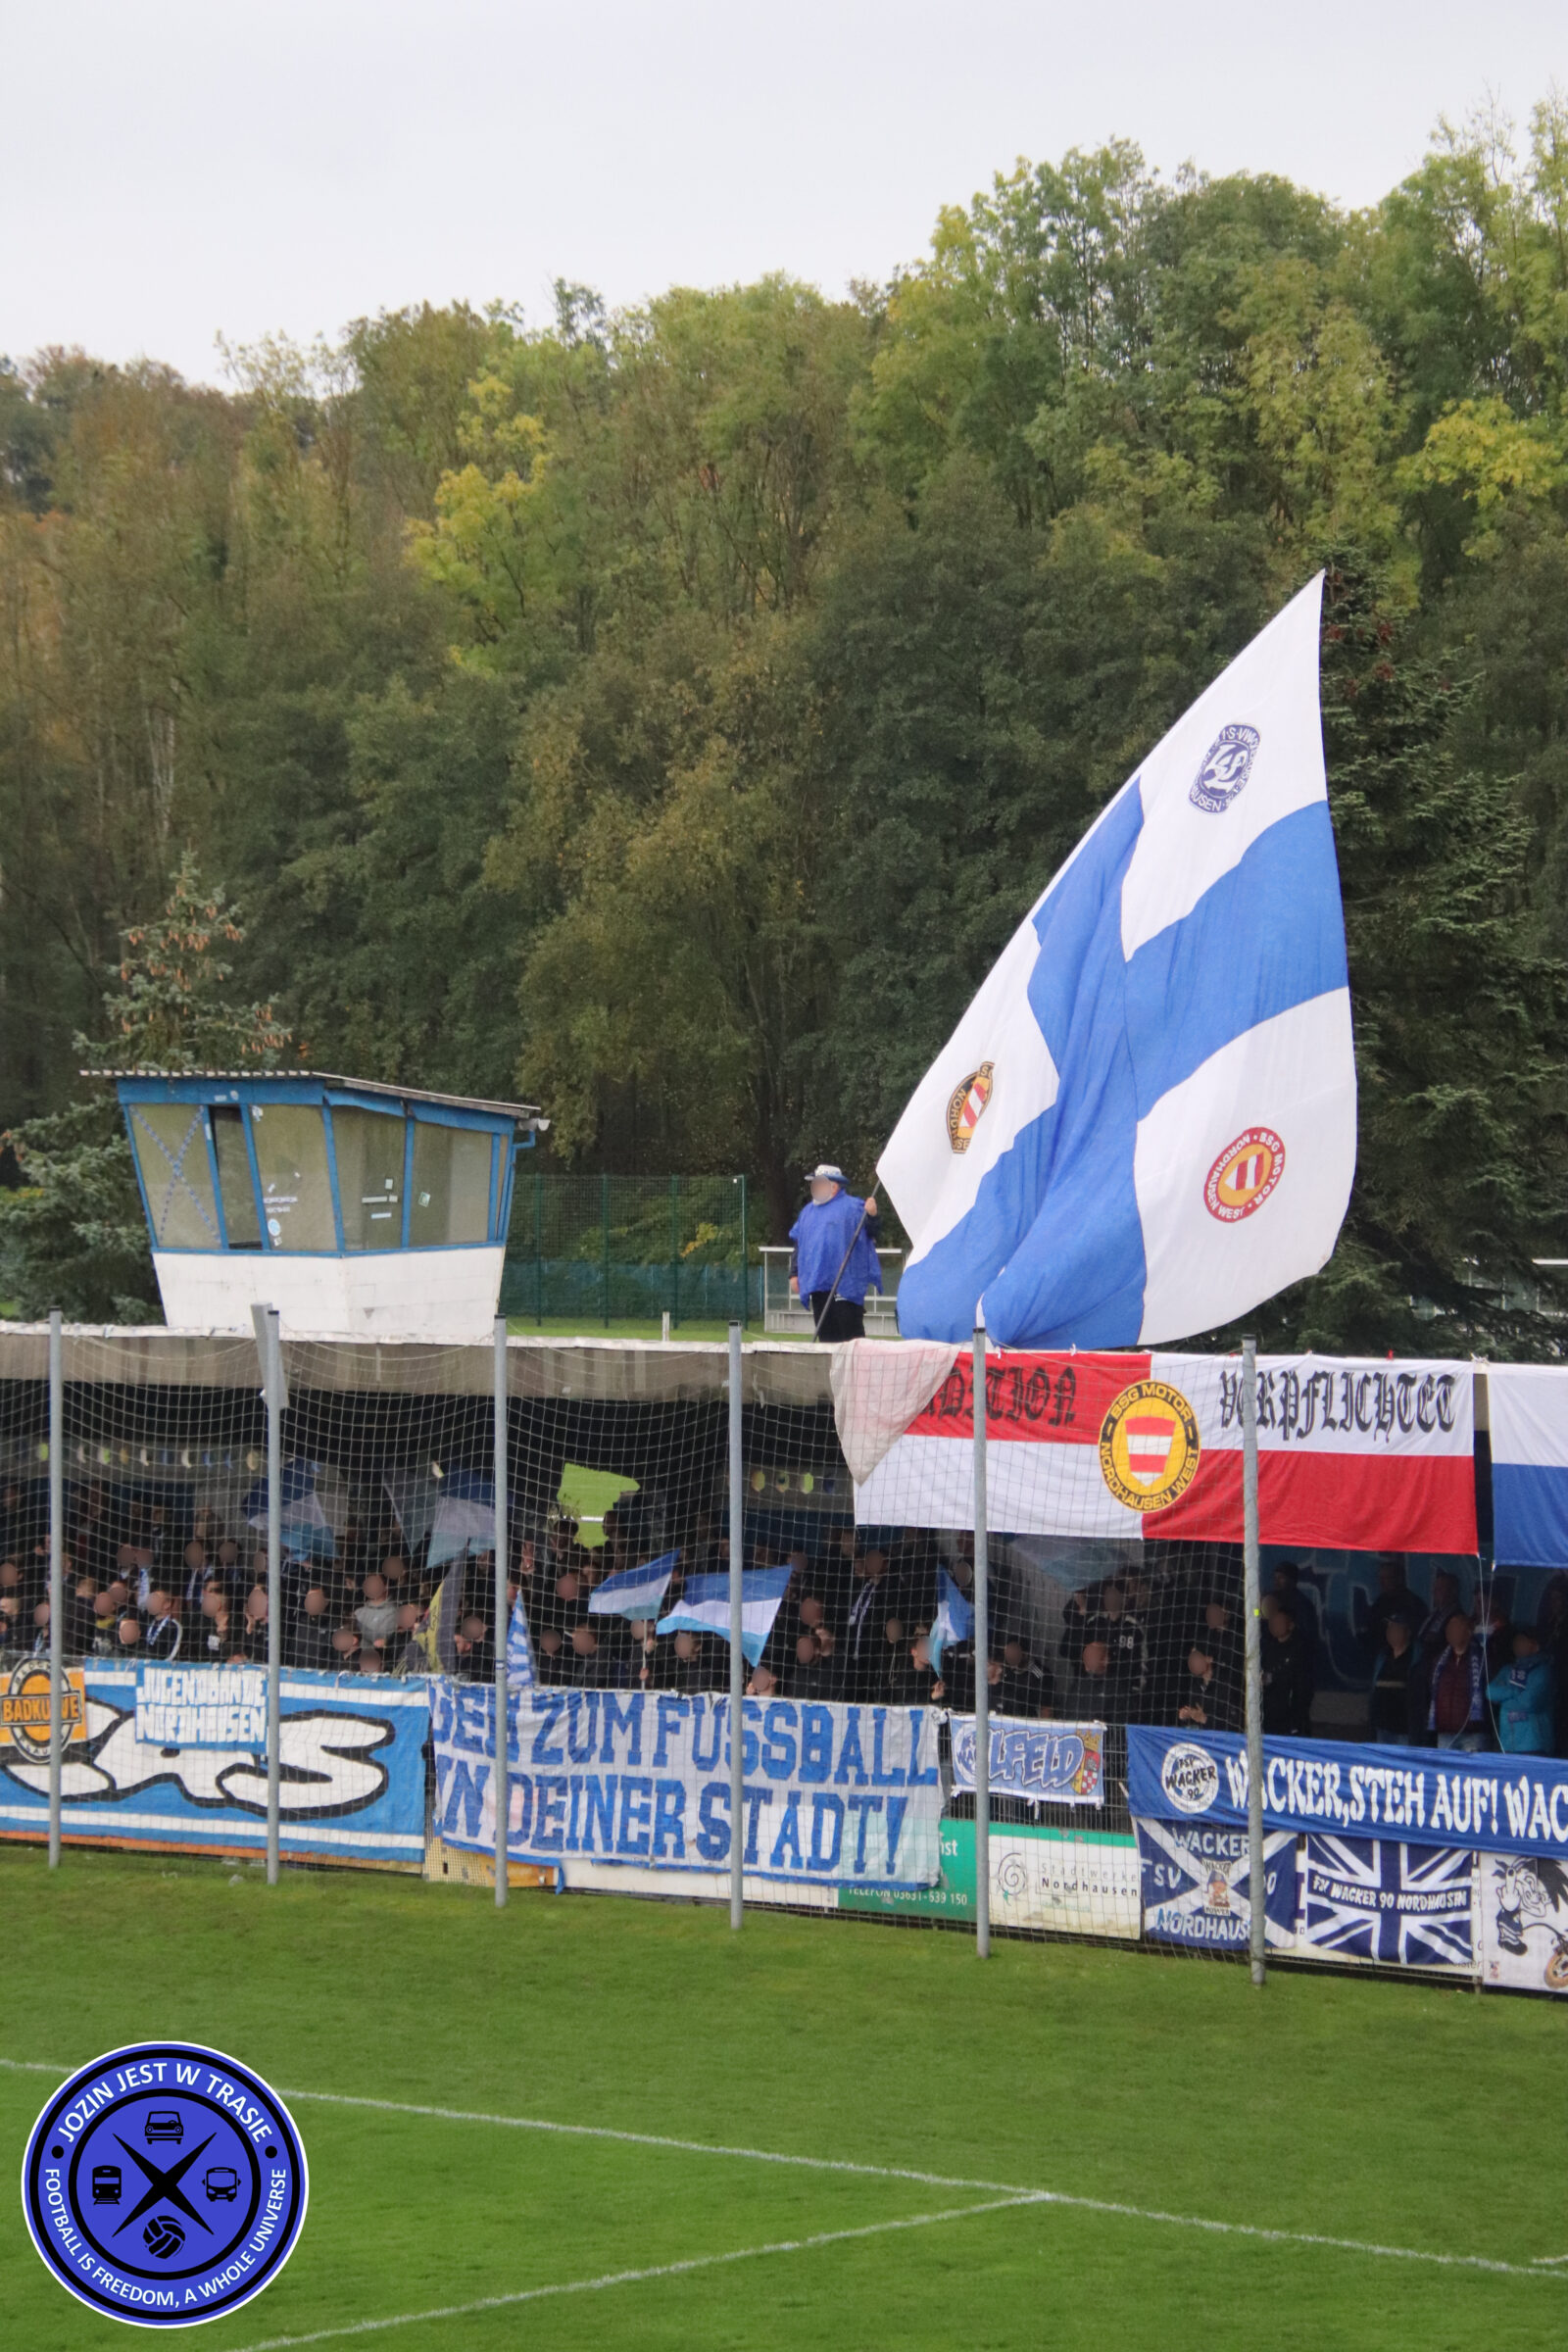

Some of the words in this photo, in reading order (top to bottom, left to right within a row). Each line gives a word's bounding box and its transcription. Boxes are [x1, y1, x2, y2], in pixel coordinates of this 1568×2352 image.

[1259, 1132, 1280, 1152] BSG
[1253, 1152, 1284, 1205] MOTOR
[1217, 1205, 1246, 1219] WEST
[1110, 1388, 1140, 1420] BSG
[1142, 1383, 1193, 1422] MOTOR
[1101, 1442, 1173, 1510] NORDHAUSEN
[1172, 1446, 1199, 1494] WEST
[530, 1691, 645, 1765] ZUM
[654, 1695, 939, 1788] FUSSBALL
[1165, 1765, 1217, 1790] WACKER
[1187, 1788, 1200, 1800] 90
[1348, 1765, 1426, 1829] STEH
[1430, 1774, 1498, 1836] AUF!
[432, 1753, 490, 1838] IN
[493, 1771, 686, 1860] DEINER
[696, 1782, 908, 1876] STADT!
[1042, 1863, 1138, 1884] Stadtwerke
[950, 1892, 968, 1906] 150
[1042, 1877, 1139, 1898] Nordhausen
[1330, 1884, 1377, 1908] WACKER
[1380, 1891, 1395, 1909] 90
